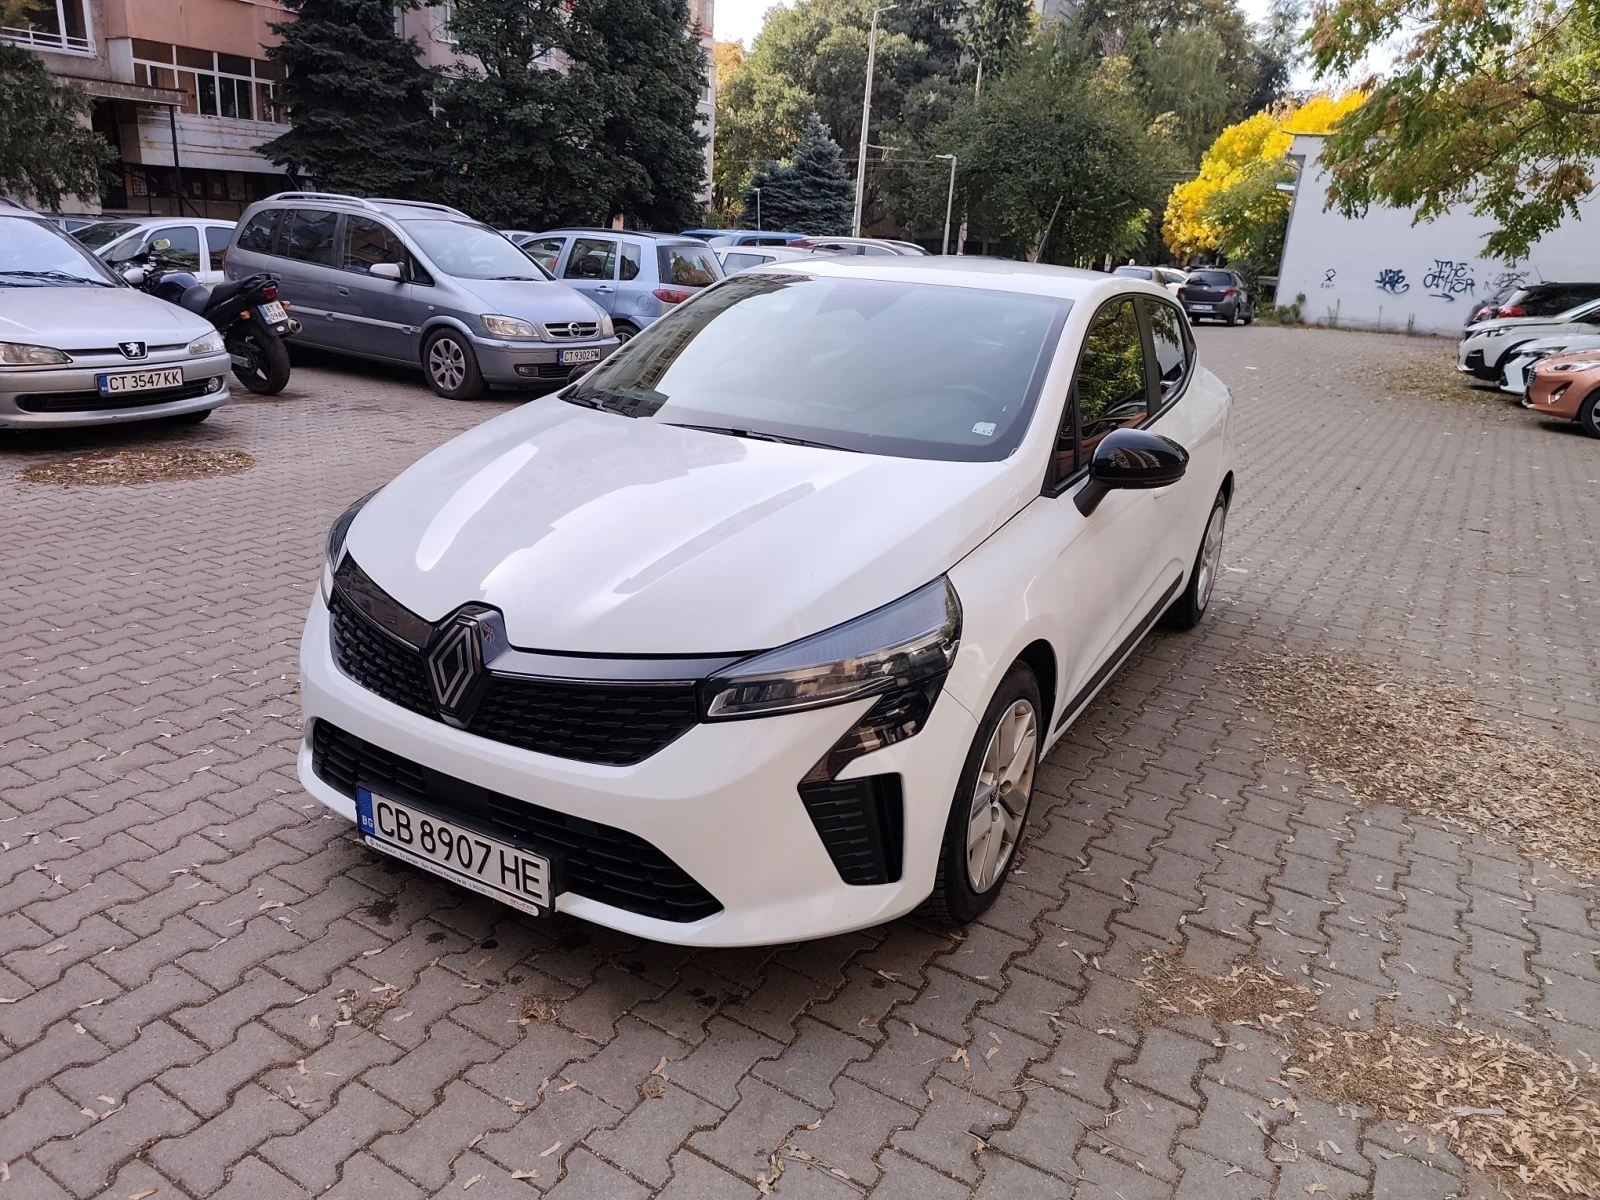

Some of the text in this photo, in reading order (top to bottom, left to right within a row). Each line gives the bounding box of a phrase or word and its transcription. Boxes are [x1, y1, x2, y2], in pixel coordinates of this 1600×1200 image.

[564, 351, 574, 361] CT
[575, 350, 590, 361] 9302
[109, 371, 181, 391] CT 3547 KK
[362, 814, 374, 828] BG
[376, 801, 413, 844] CB
[420, 819, 492, 875] 8907
[499, 849, 543, 900] HE
